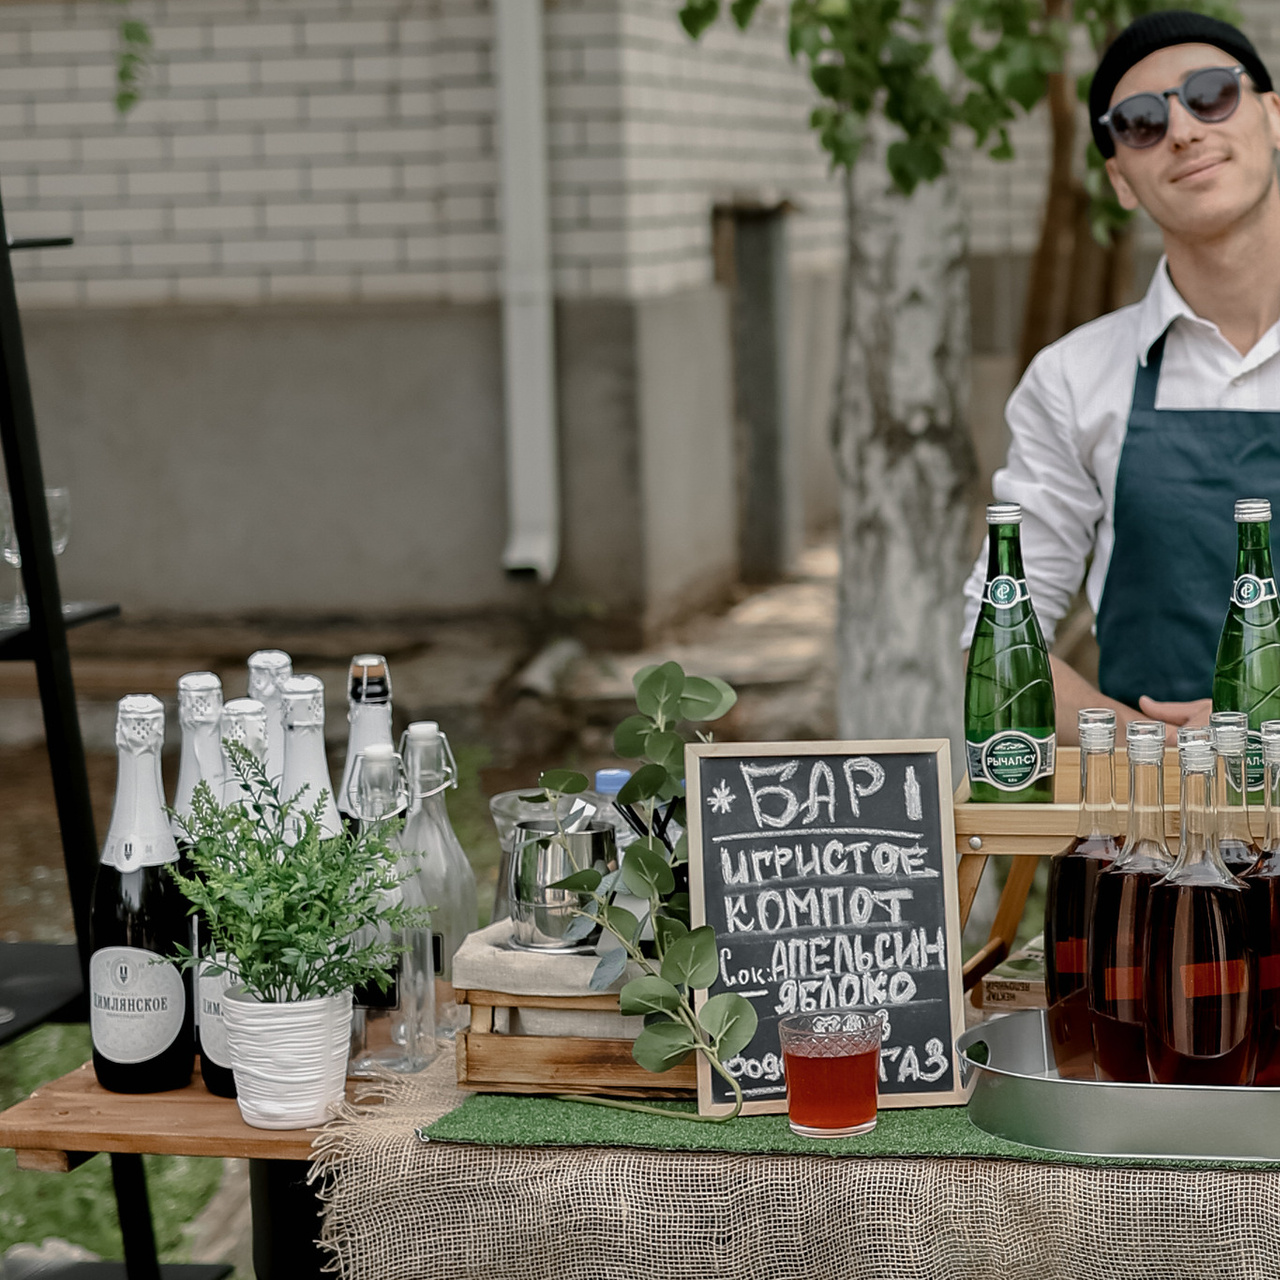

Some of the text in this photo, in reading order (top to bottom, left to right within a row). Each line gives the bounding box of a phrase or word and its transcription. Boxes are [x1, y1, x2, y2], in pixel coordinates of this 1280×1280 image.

[987, 753, 1036, 766] РЫЧАЛ-СУ
[720, 839, 940, 885] ИГРИСТОЕ
[724, 887, 913, 933] КОМПОТ
[772, 927, 946, 982] АПЕЛЬСИН
[775, 971, 917, 1015] ЯБЛОКО
